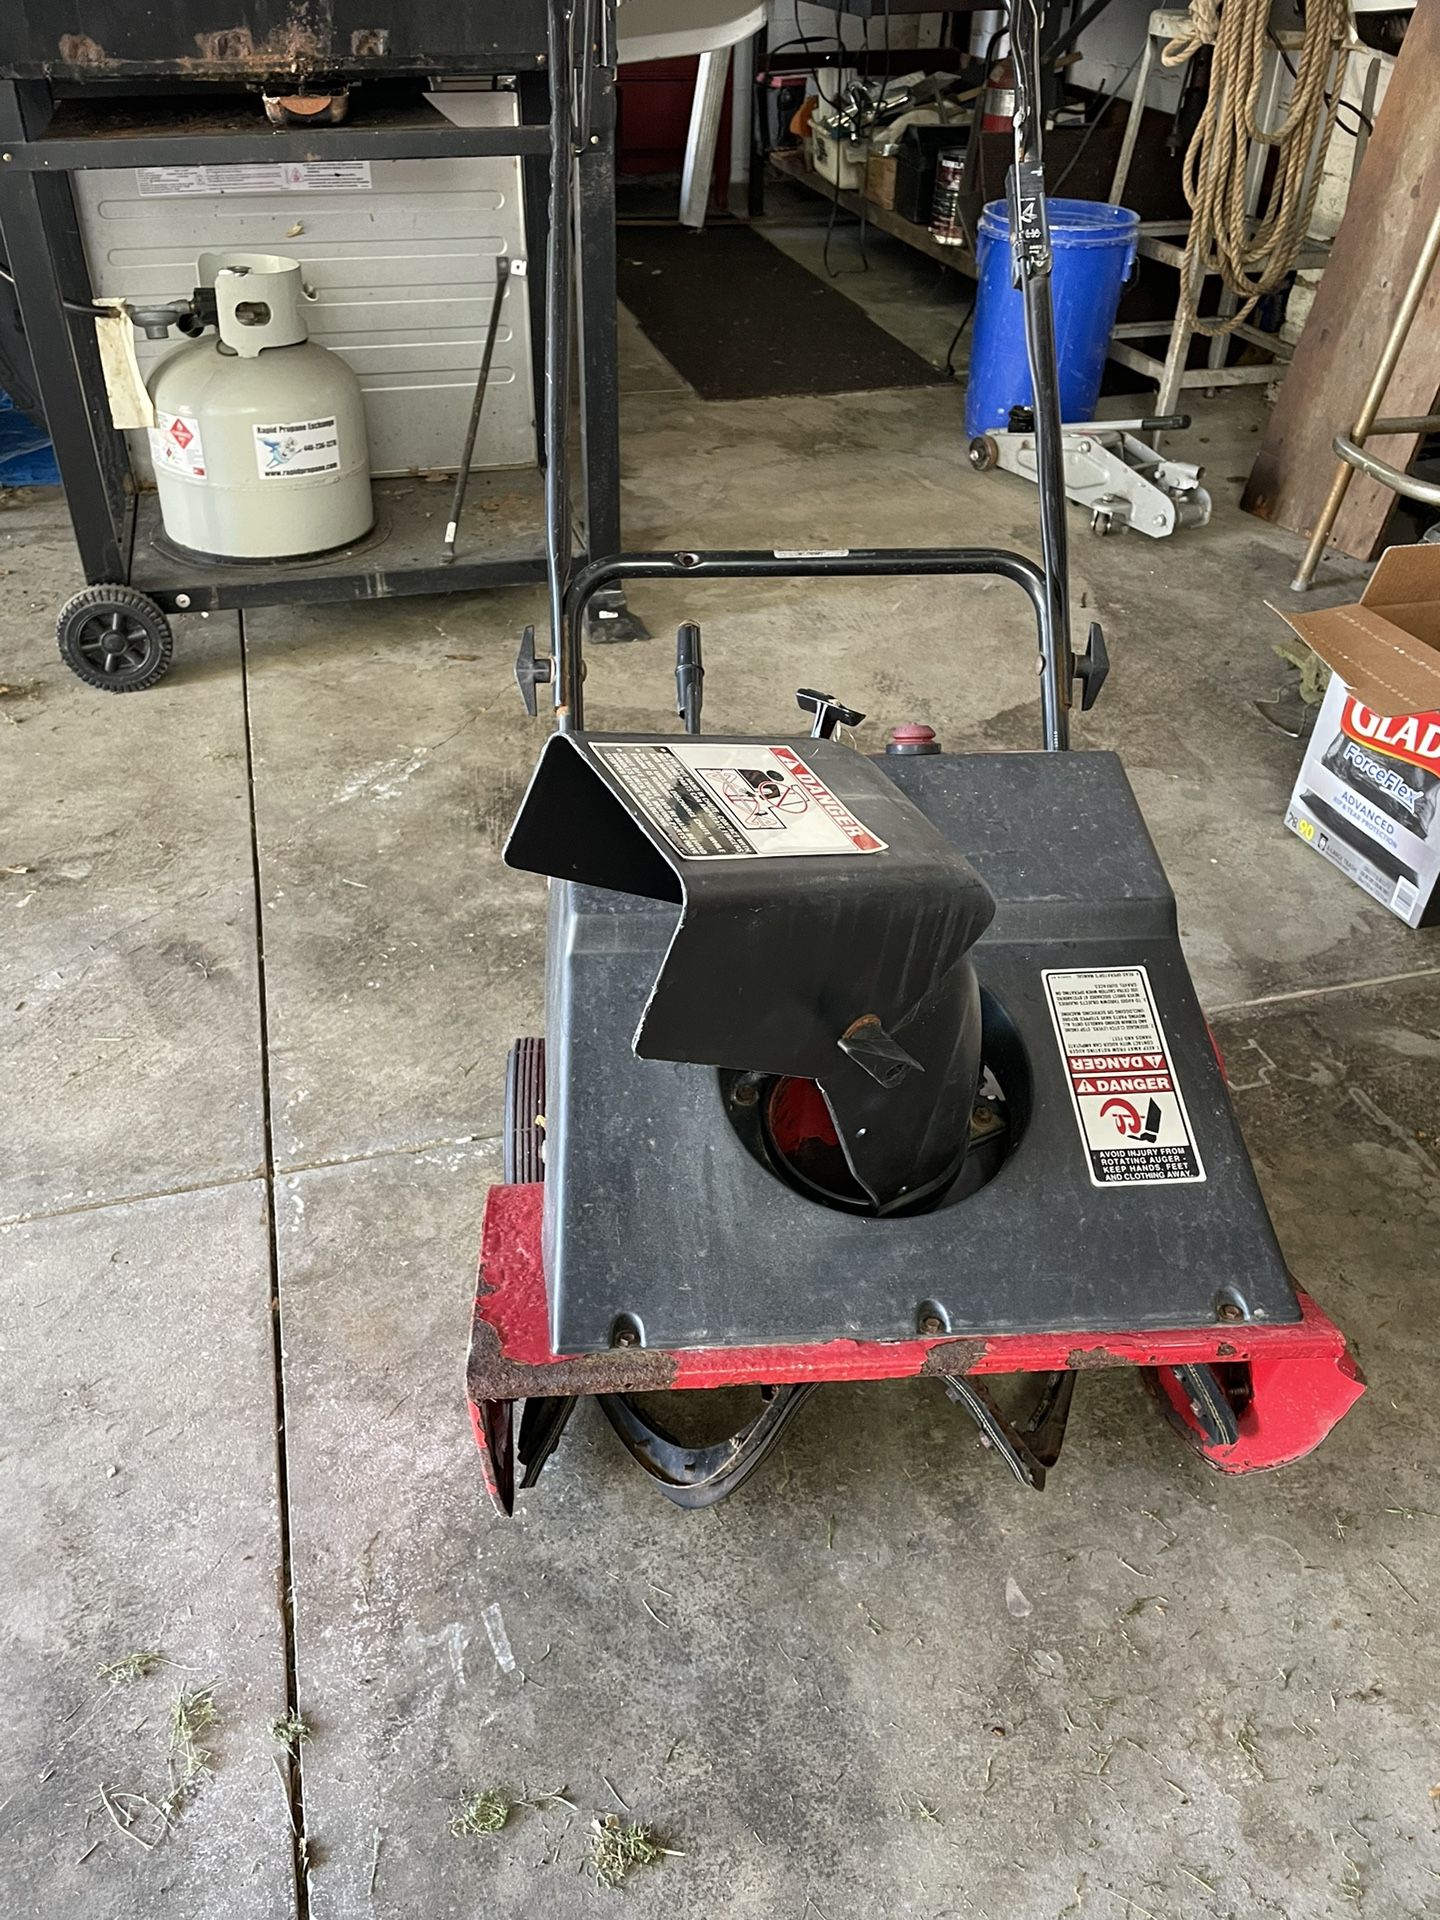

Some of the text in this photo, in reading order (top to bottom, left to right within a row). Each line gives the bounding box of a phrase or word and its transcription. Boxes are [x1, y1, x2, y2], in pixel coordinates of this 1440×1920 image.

[279, 424, 307, 433] Propane
[1351, 698, 1440, 759] GLAD
[1343, 741, 1425, 808] ForceFlex
[795, 773, 866, 838] DANGER
[1341, 791, 1395, 835] ADVANCED
[1287, 812, 1315, 841] 78 90
[1071, 1056, 1144, 1070] DANGER
[1096, 1078, 1170, 1091] DANGER
[1099, 1147, 1185, 1158] AVOID INJURY FROM
[1101, 1157, 1147, 1166] ROTATING
[1149, 1155, 1180, 1164] AUGER
[1103, 1165, 1127, 1174] KEEP
[1165, 1162, 1188, 1170] FEET
[1105, 1169, 1195, 1181] AND CLOTHING AWAY.
